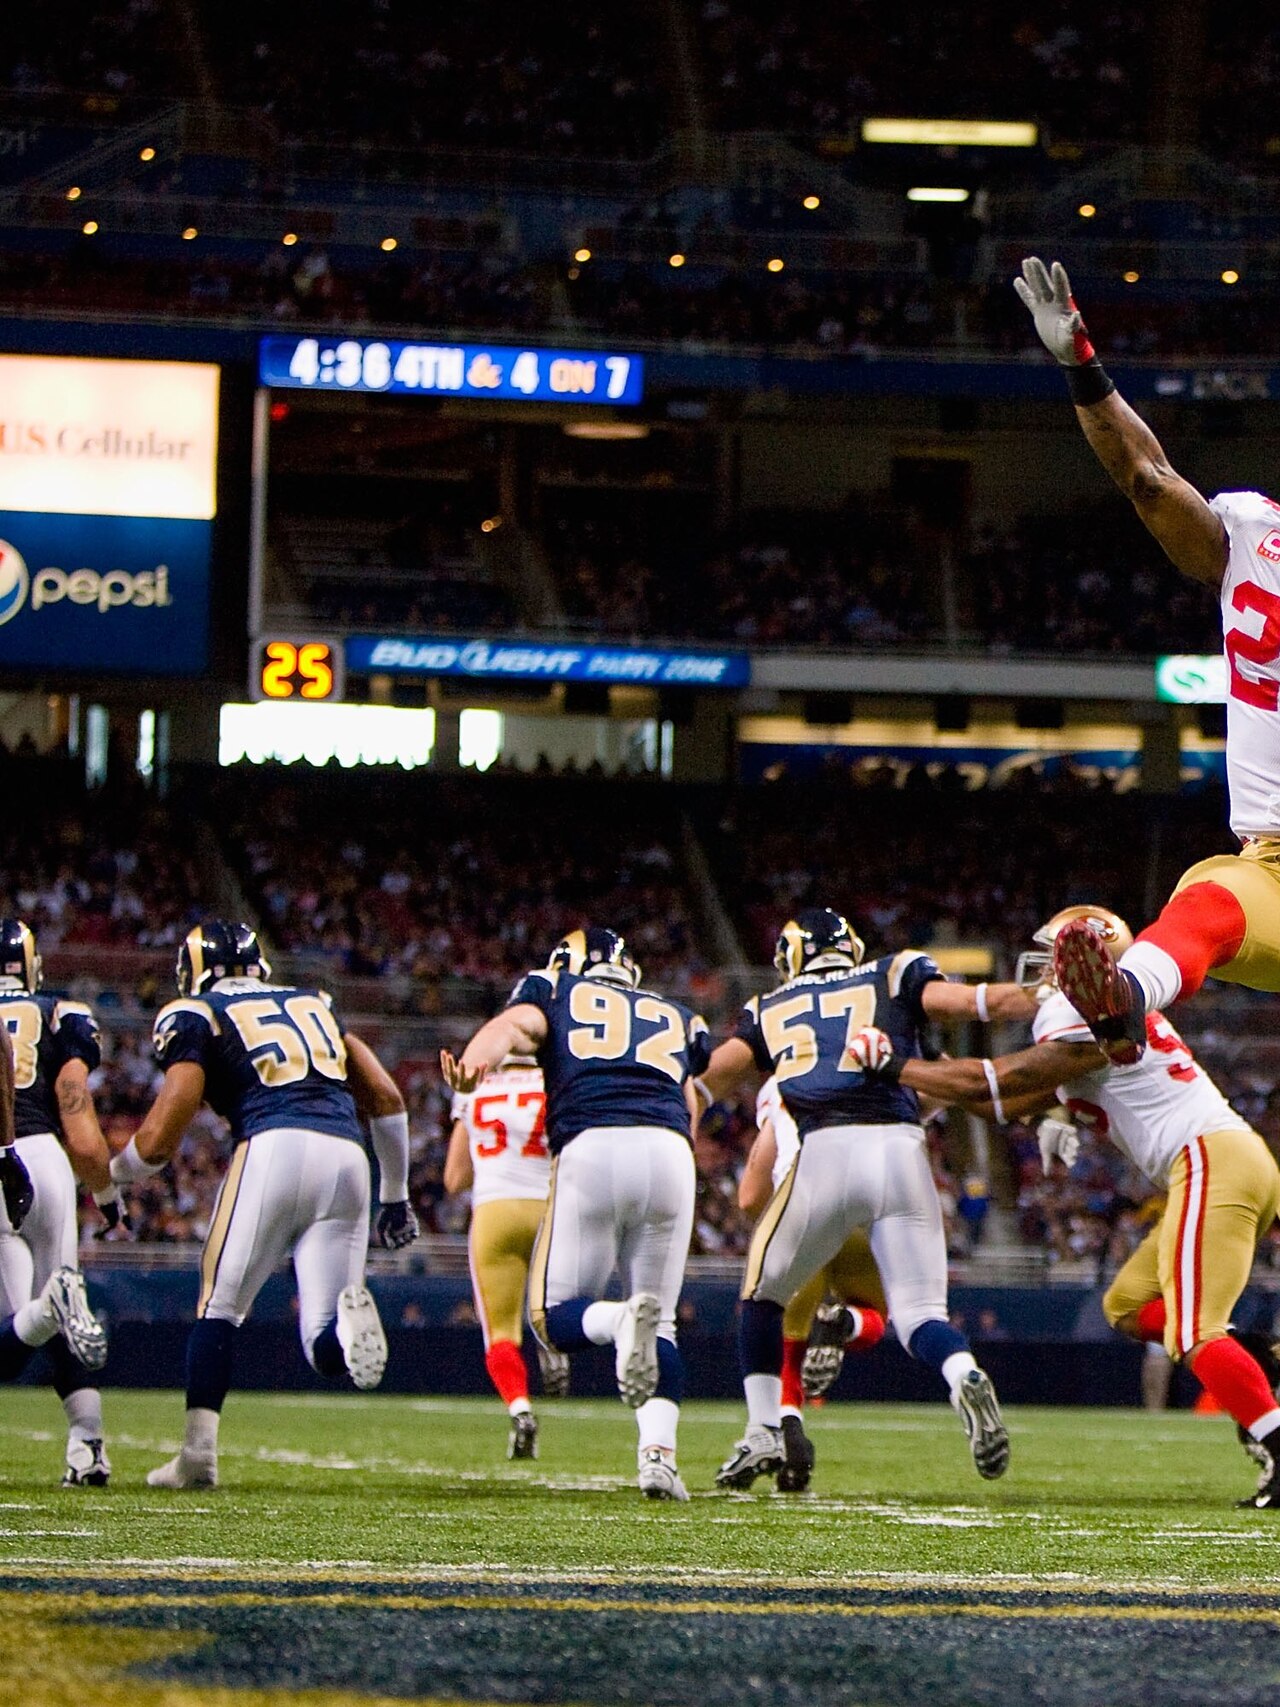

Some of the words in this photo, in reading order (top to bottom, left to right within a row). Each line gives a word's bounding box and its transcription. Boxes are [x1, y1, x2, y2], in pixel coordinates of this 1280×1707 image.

[394, 345, 465, 390] 4TH
[466, 353, 503, 389] &
[510, 352, 540, 394] 4
[549, 358, 597, 394] ON
[605, 356, 630, 399] 7
[56, 424, 191, 459] Cellular
[32, 564, 169, 613] pepsi
[262, 642, 333, 699] 25
[225, 995, 348, 1087] 50
[568, 981, 690, 1084] 92
[760, 984, 876, 1083] 57
[472, 1091, 548, 1158] 57
